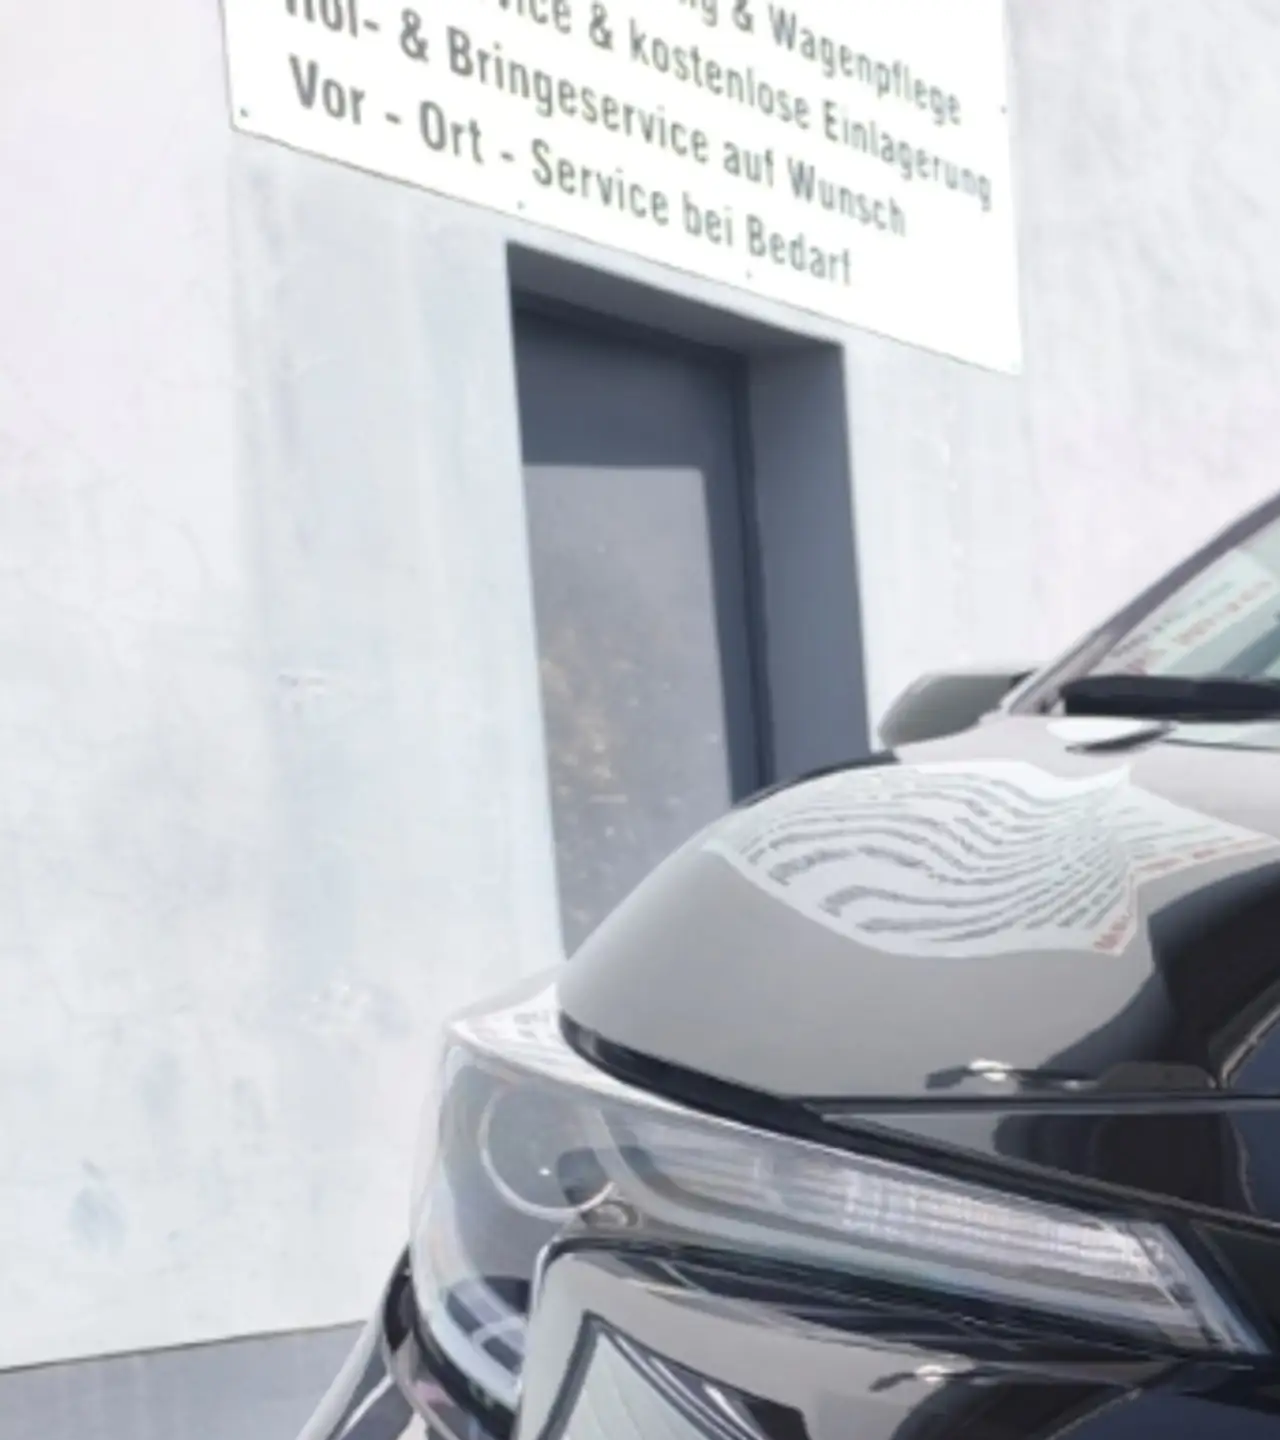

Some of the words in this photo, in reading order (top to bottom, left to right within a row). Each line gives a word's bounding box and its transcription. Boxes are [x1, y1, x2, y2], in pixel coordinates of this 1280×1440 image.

[288, 52, 366, 125] Vor
[418, 100, 485, 164] Ort
[531, 137, 670, 227] Service
[681, 191, 734, 247] bei
[744, 213, 851, 286] Bedarf
[399, 8, 429, 62] &
[446, 25, 709, 164] Bringeservice
[722, 141, 775, 188] auf
[786, 154, 907, 237] Wunsch
[589, 0, 613, 50] &
[629, 16, 811, 130] kostenlose
[821, 98, 993, 213] Einlagerung
[767, 1, 963, 127] Wagenpflege
